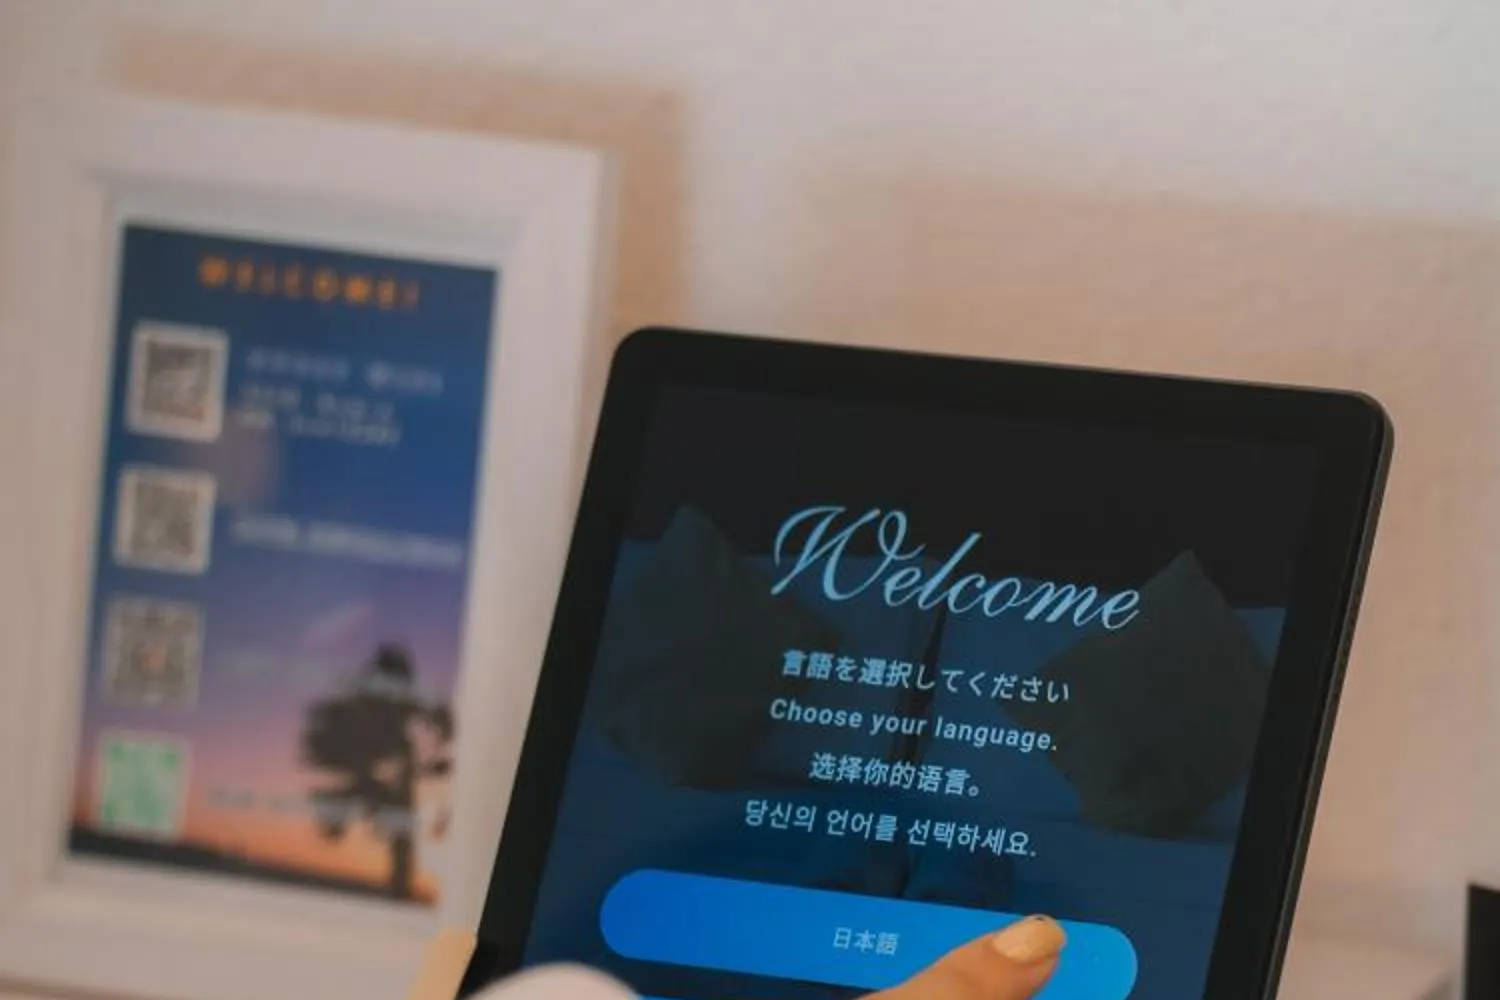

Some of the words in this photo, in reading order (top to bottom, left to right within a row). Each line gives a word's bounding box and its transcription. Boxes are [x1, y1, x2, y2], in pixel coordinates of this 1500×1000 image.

[771, 505, 1141, 630] Welcome
[782, 650, 1070, 702] 言語を選択してください
[770, 699, 863, 728] Choose
[870, 713, 927, 736] your
[935, 717, 1057, 752] language.
[809, 752, 980, 797] 选择你的语言。
[745, 799, 817, 833] 당신의
[826, 809, 898, 843] 언어를
[907, 818, 1037, 857] 선택하세요.
[831, 927, 899, 957] 日本語
